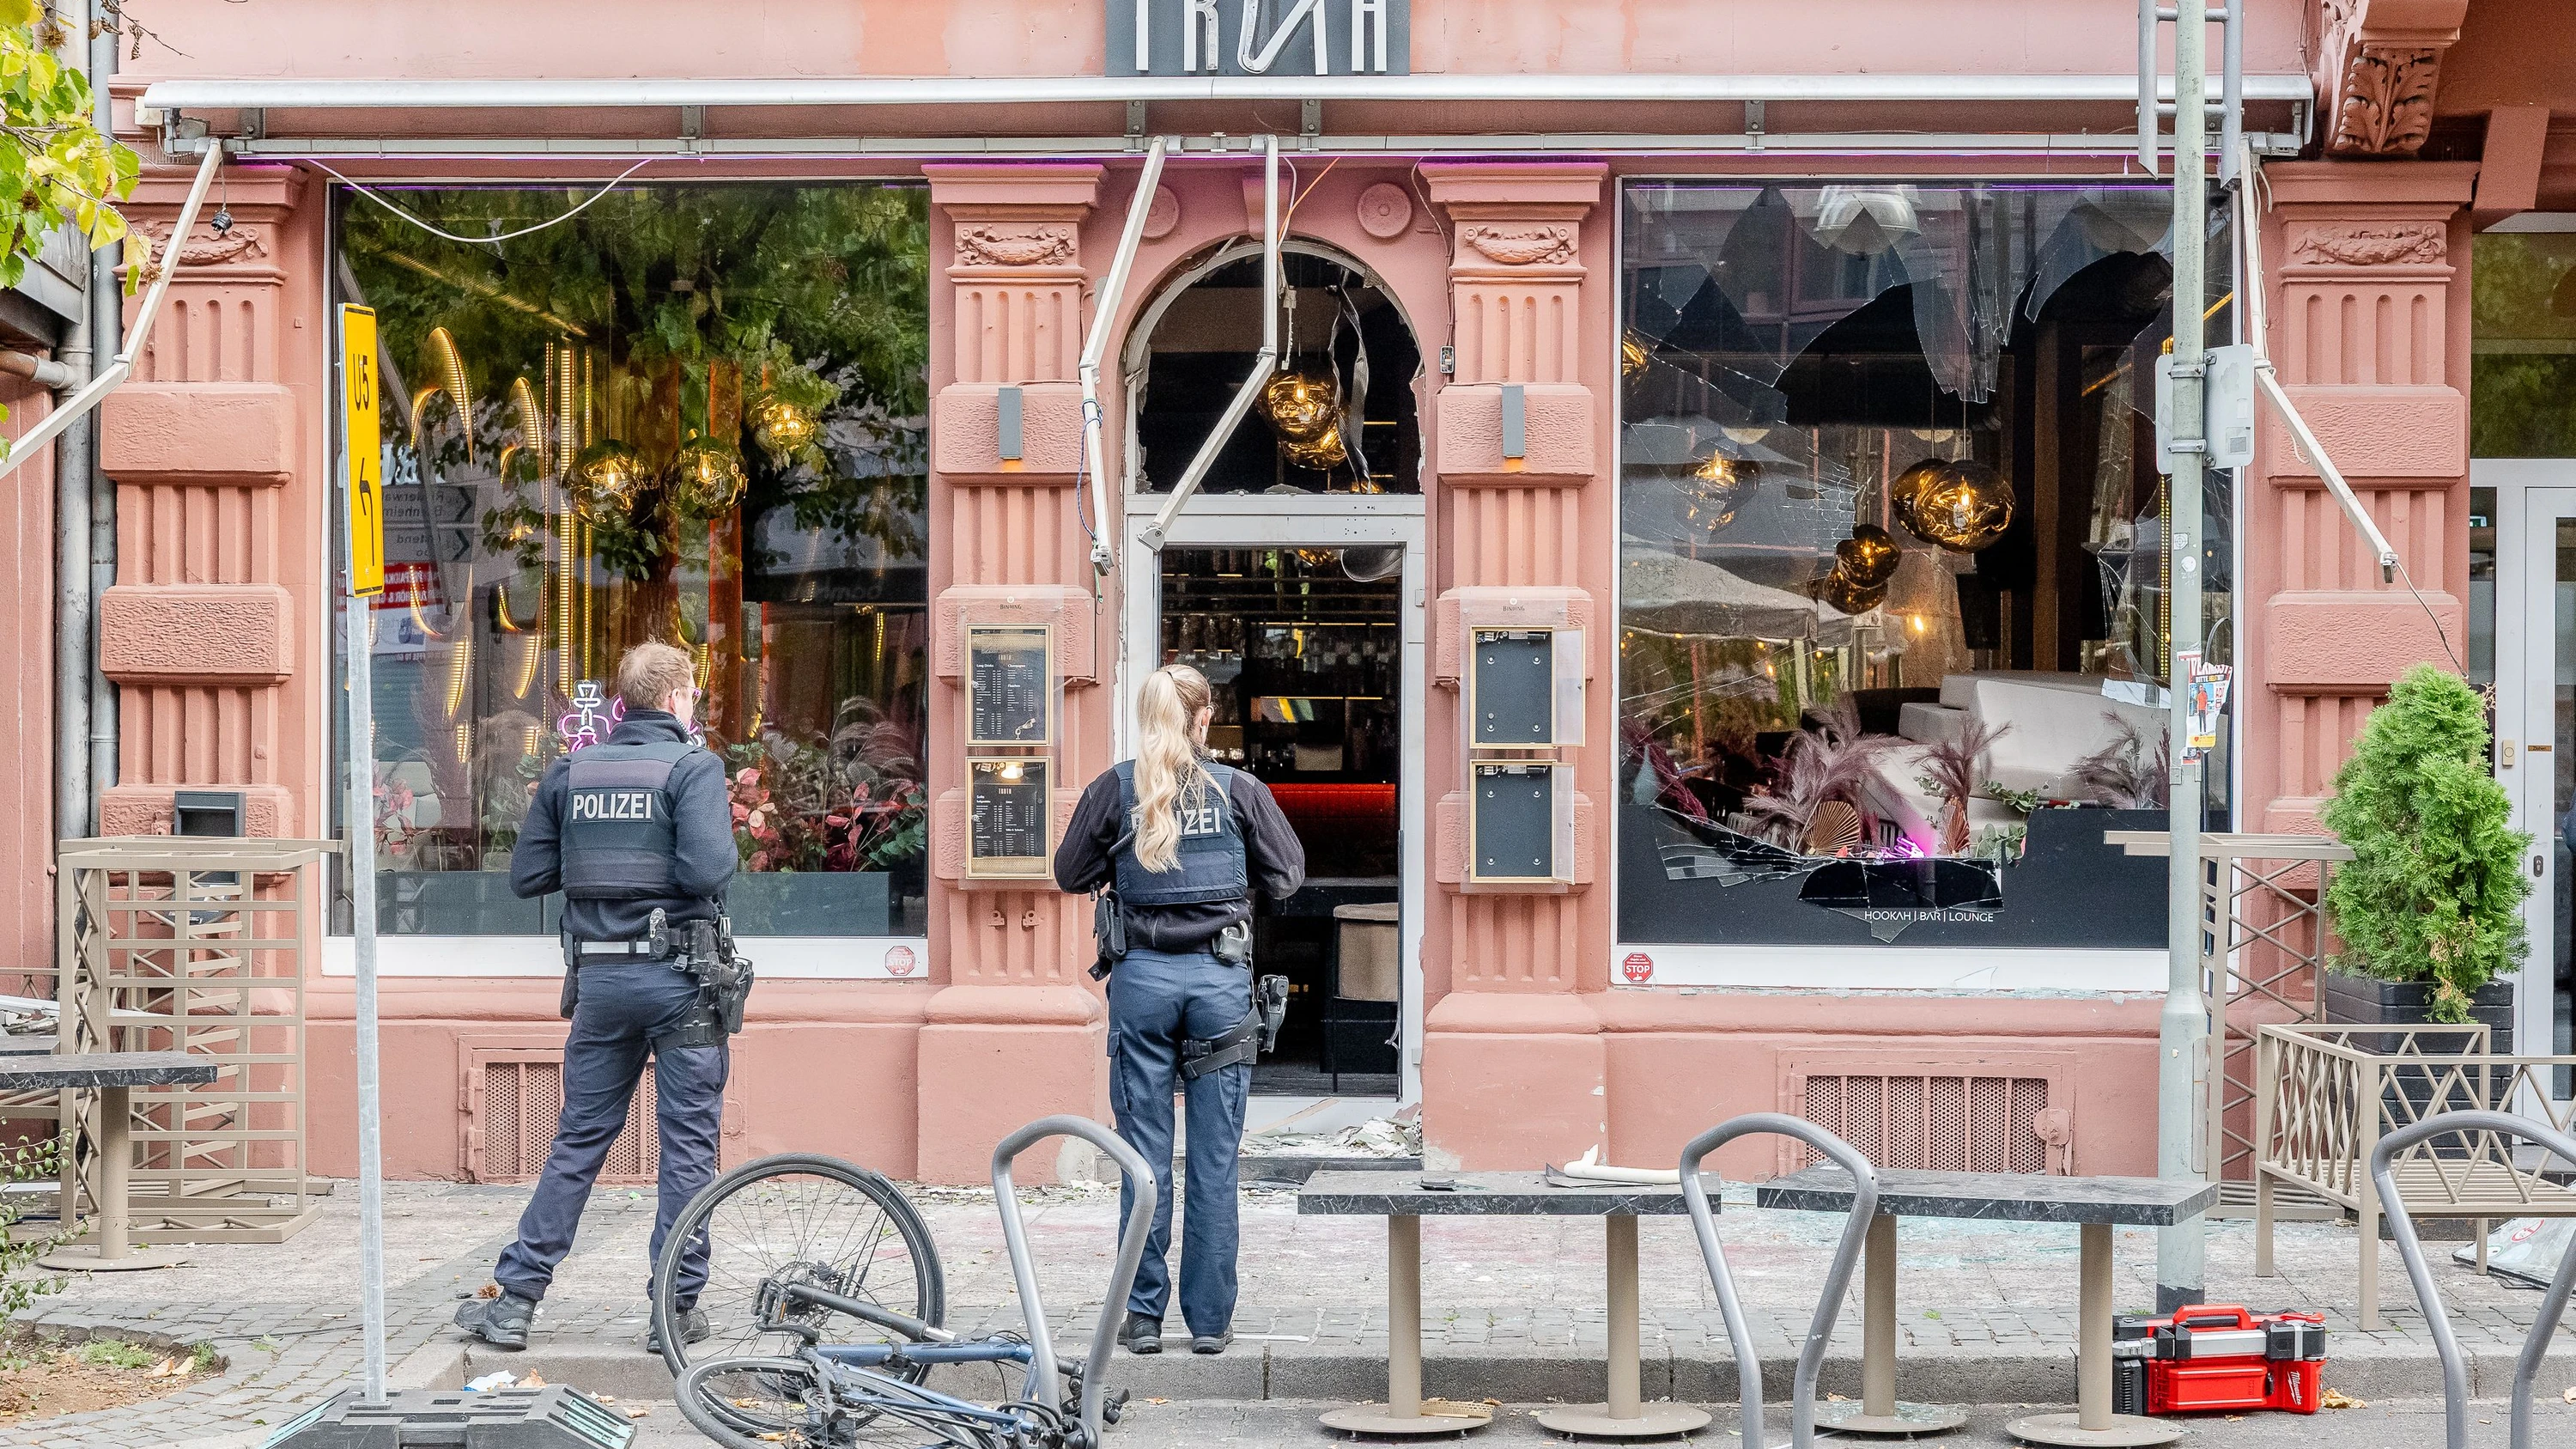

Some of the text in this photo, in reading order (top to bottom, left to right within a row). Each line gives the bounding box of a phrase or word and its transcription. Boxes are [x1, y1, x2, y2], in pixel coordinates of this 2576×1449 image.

[352, 353, 370, 411] U5
[572, 792, 653, 820] POLIZEI
[1864, 910, 1911, 921] HOOKAH
[1919, 911, 1941, 921] BAR
[1948, 912, 1994, 922] LOUNGE
[889, 959, 912, 967] STOP
[2290, 1371, 2302, 1405] Milwaukee
